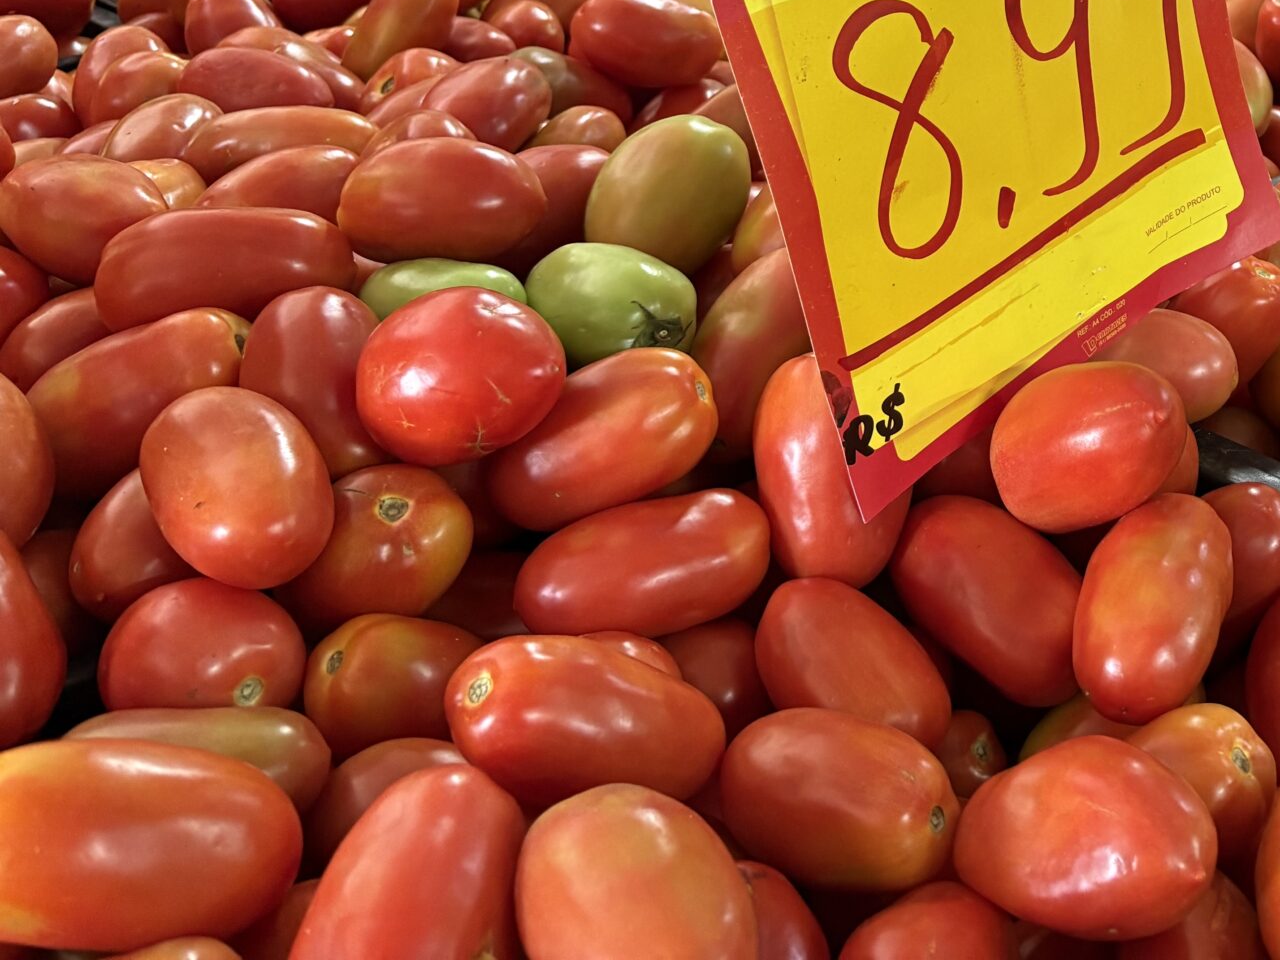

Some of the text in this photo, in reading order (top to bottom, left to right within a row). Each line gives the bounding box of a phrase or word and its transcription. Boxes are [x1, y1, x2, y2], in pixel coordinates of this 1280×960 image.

[1145, 185, 1221, 237] VALIDADE DO PRODUTO
[842, 382, 905, 466] R$
